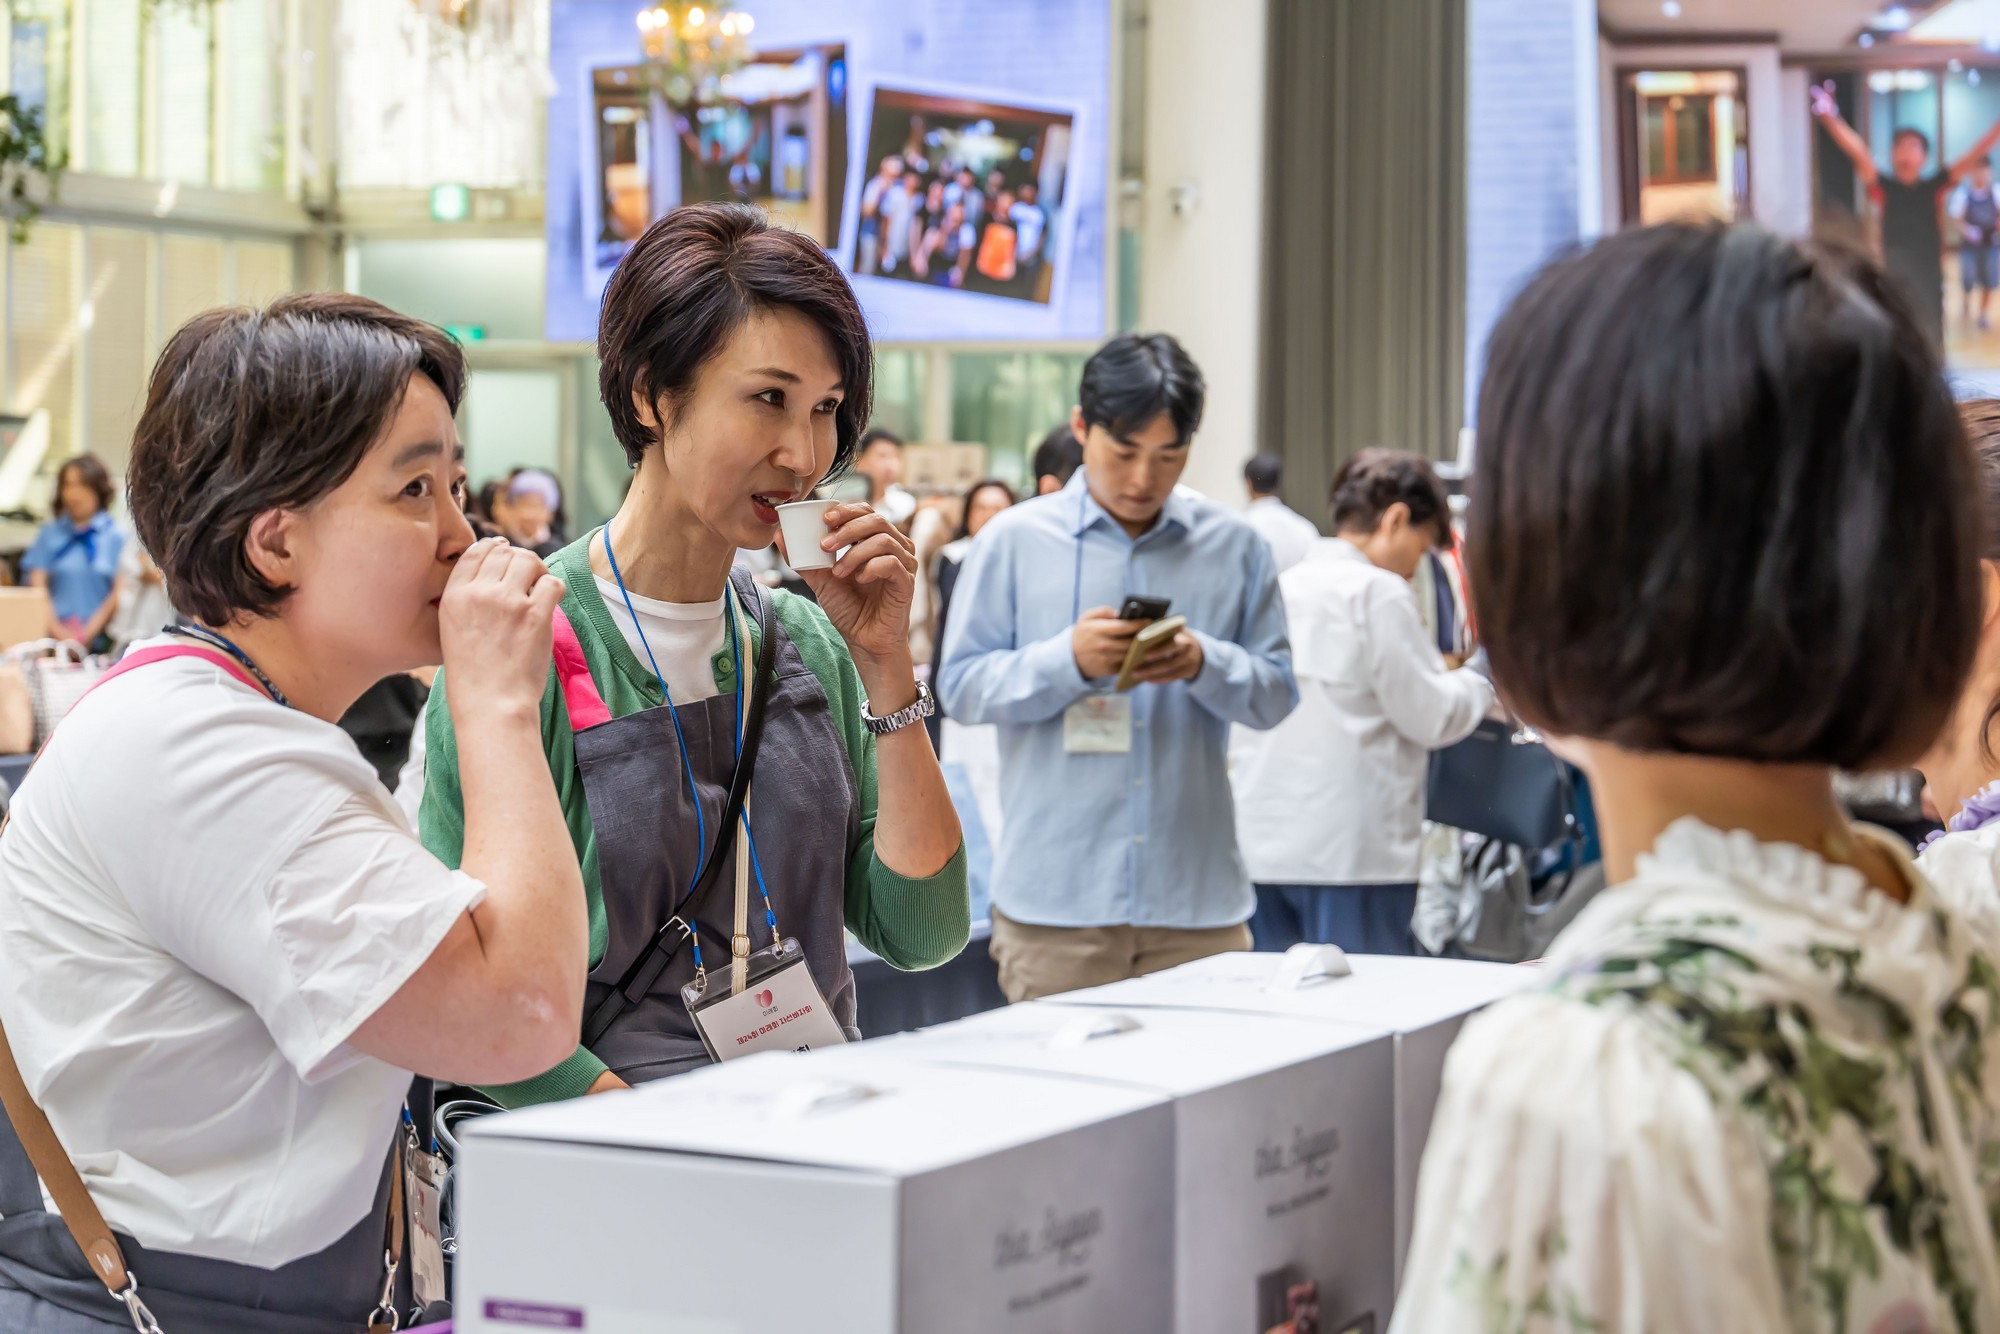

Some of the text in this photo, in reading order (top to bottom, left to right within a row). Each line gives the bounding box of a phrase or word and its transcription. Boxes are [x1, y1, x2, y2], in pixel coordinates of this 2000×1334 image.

[736, 1005, 813, 1045] 제24회 미래회 자선바자회
